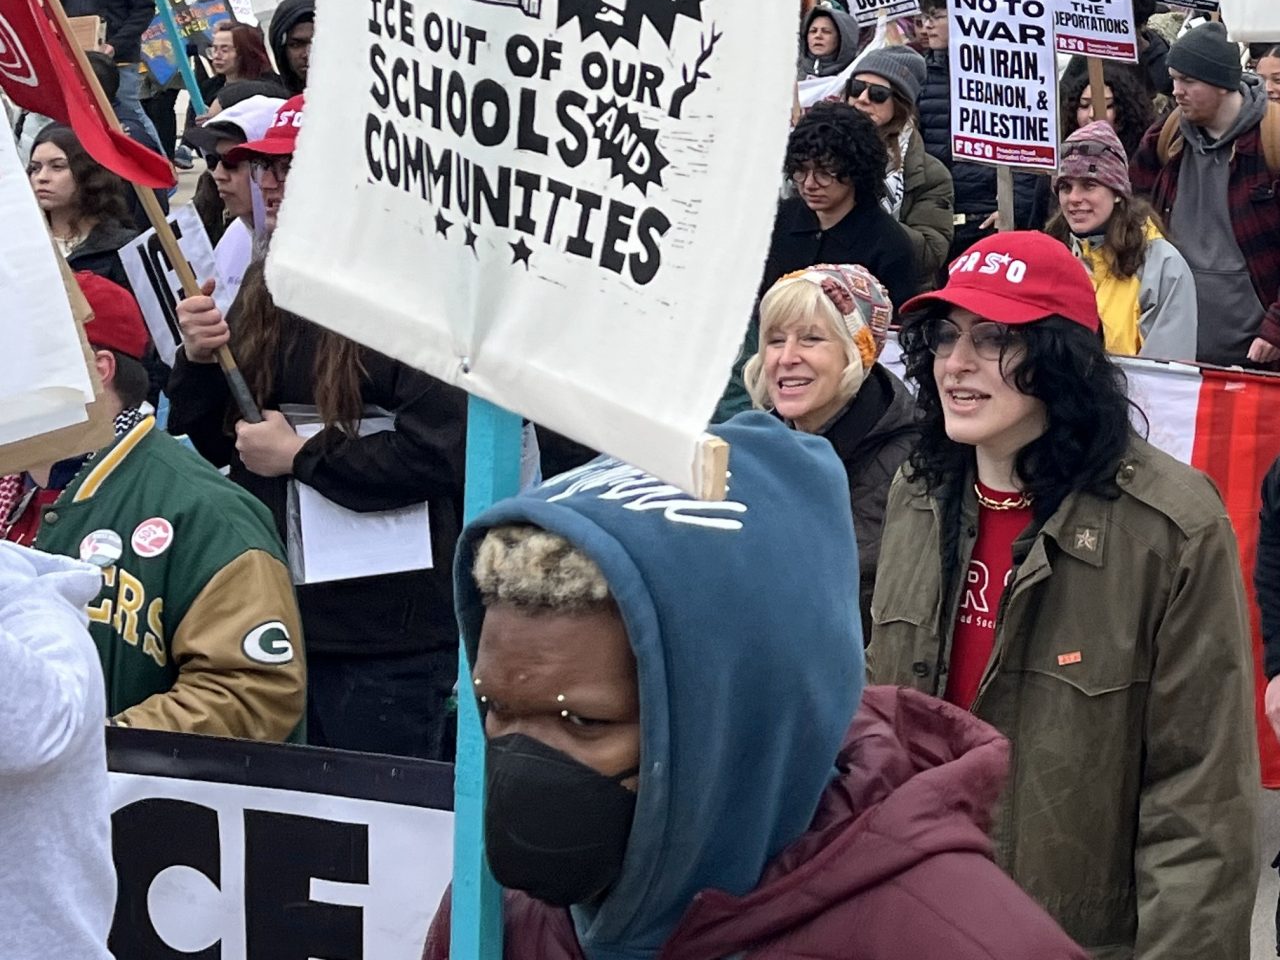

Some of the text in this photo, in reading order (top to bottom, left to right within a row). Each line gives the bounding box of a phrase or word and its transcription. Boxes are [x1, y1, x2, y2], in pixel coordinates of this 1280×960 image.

[1054, 10, 1130, 35] EPORTATIONS
[1071, 1, 1106, 15] THE
[955, 16, 1046, 47] WAR
[1056, 36, 1084, 51] RSO
[424, 11, 488, 66] OUT
[505, 33, 563, 81] OF
[581, 51, 665, 109] OUR
[959, 43, 986, 75] ON
[990, 48, 1046, 85] IRAN,
[369, 43, 652, 175] SCHOOLS AND
[958, 77, 1049, 113] LEBANON, &
[959, 106, 1050, 142] PALESTINE
[955, 140, 993, 158] FRSO
[364, 112, 672, 286] COMMUNITIES
